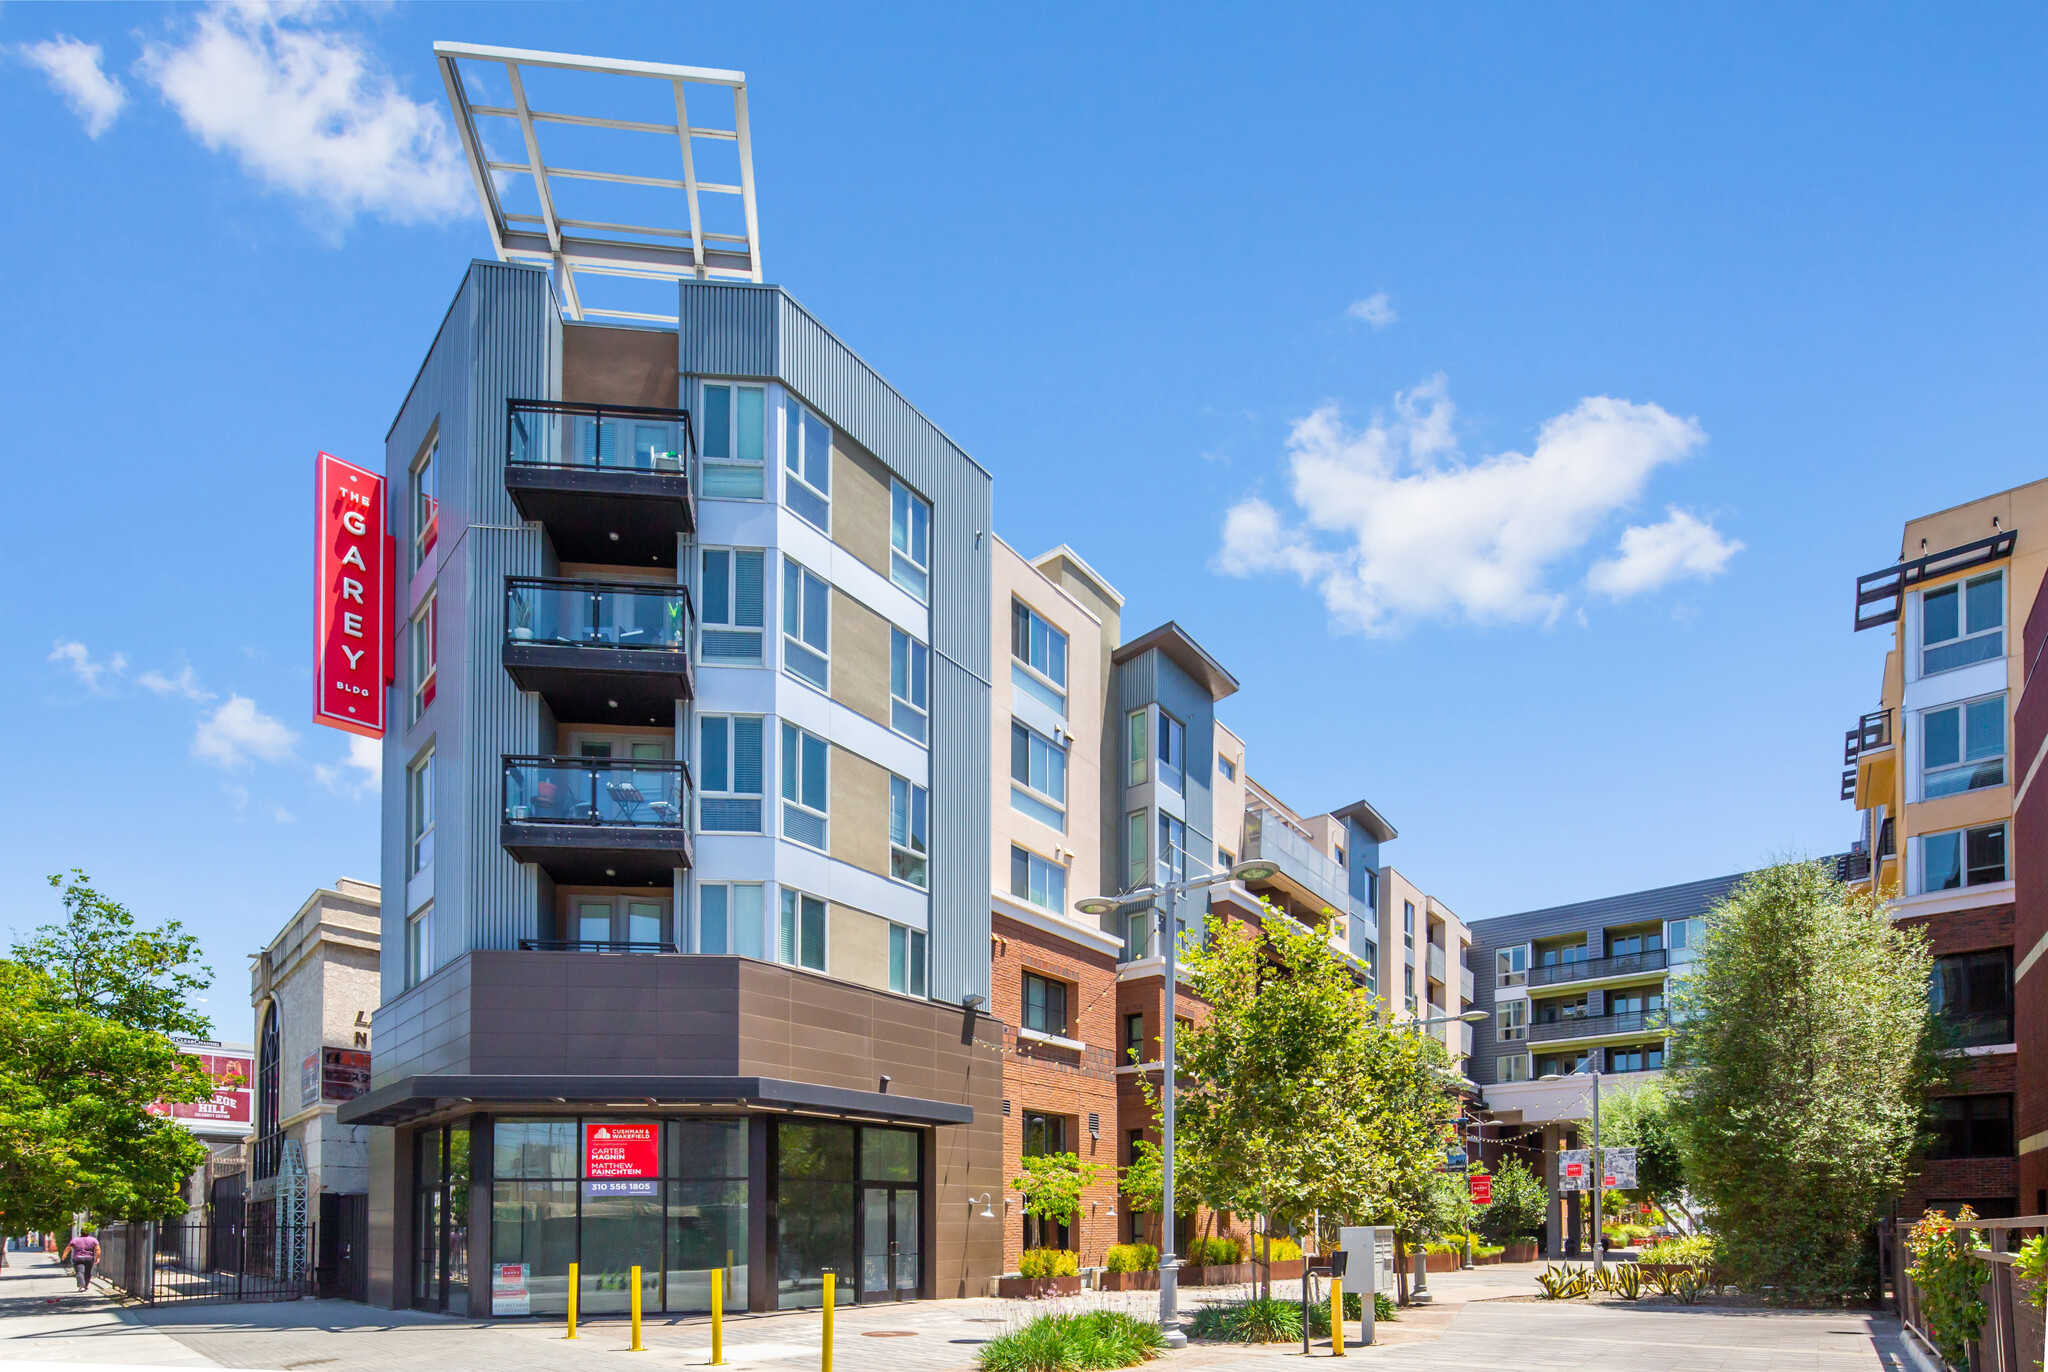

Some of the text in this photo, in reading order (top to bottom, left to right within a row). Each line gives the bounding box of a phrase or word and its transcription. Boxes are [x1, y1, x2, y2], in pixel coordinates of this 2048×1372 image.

[339, 487, 370, 507] THE
[341, 511, 366, 670] GAREY
[336, 681, 369, 697] BLDG
[198, 1103, 228, 1114] HILL
